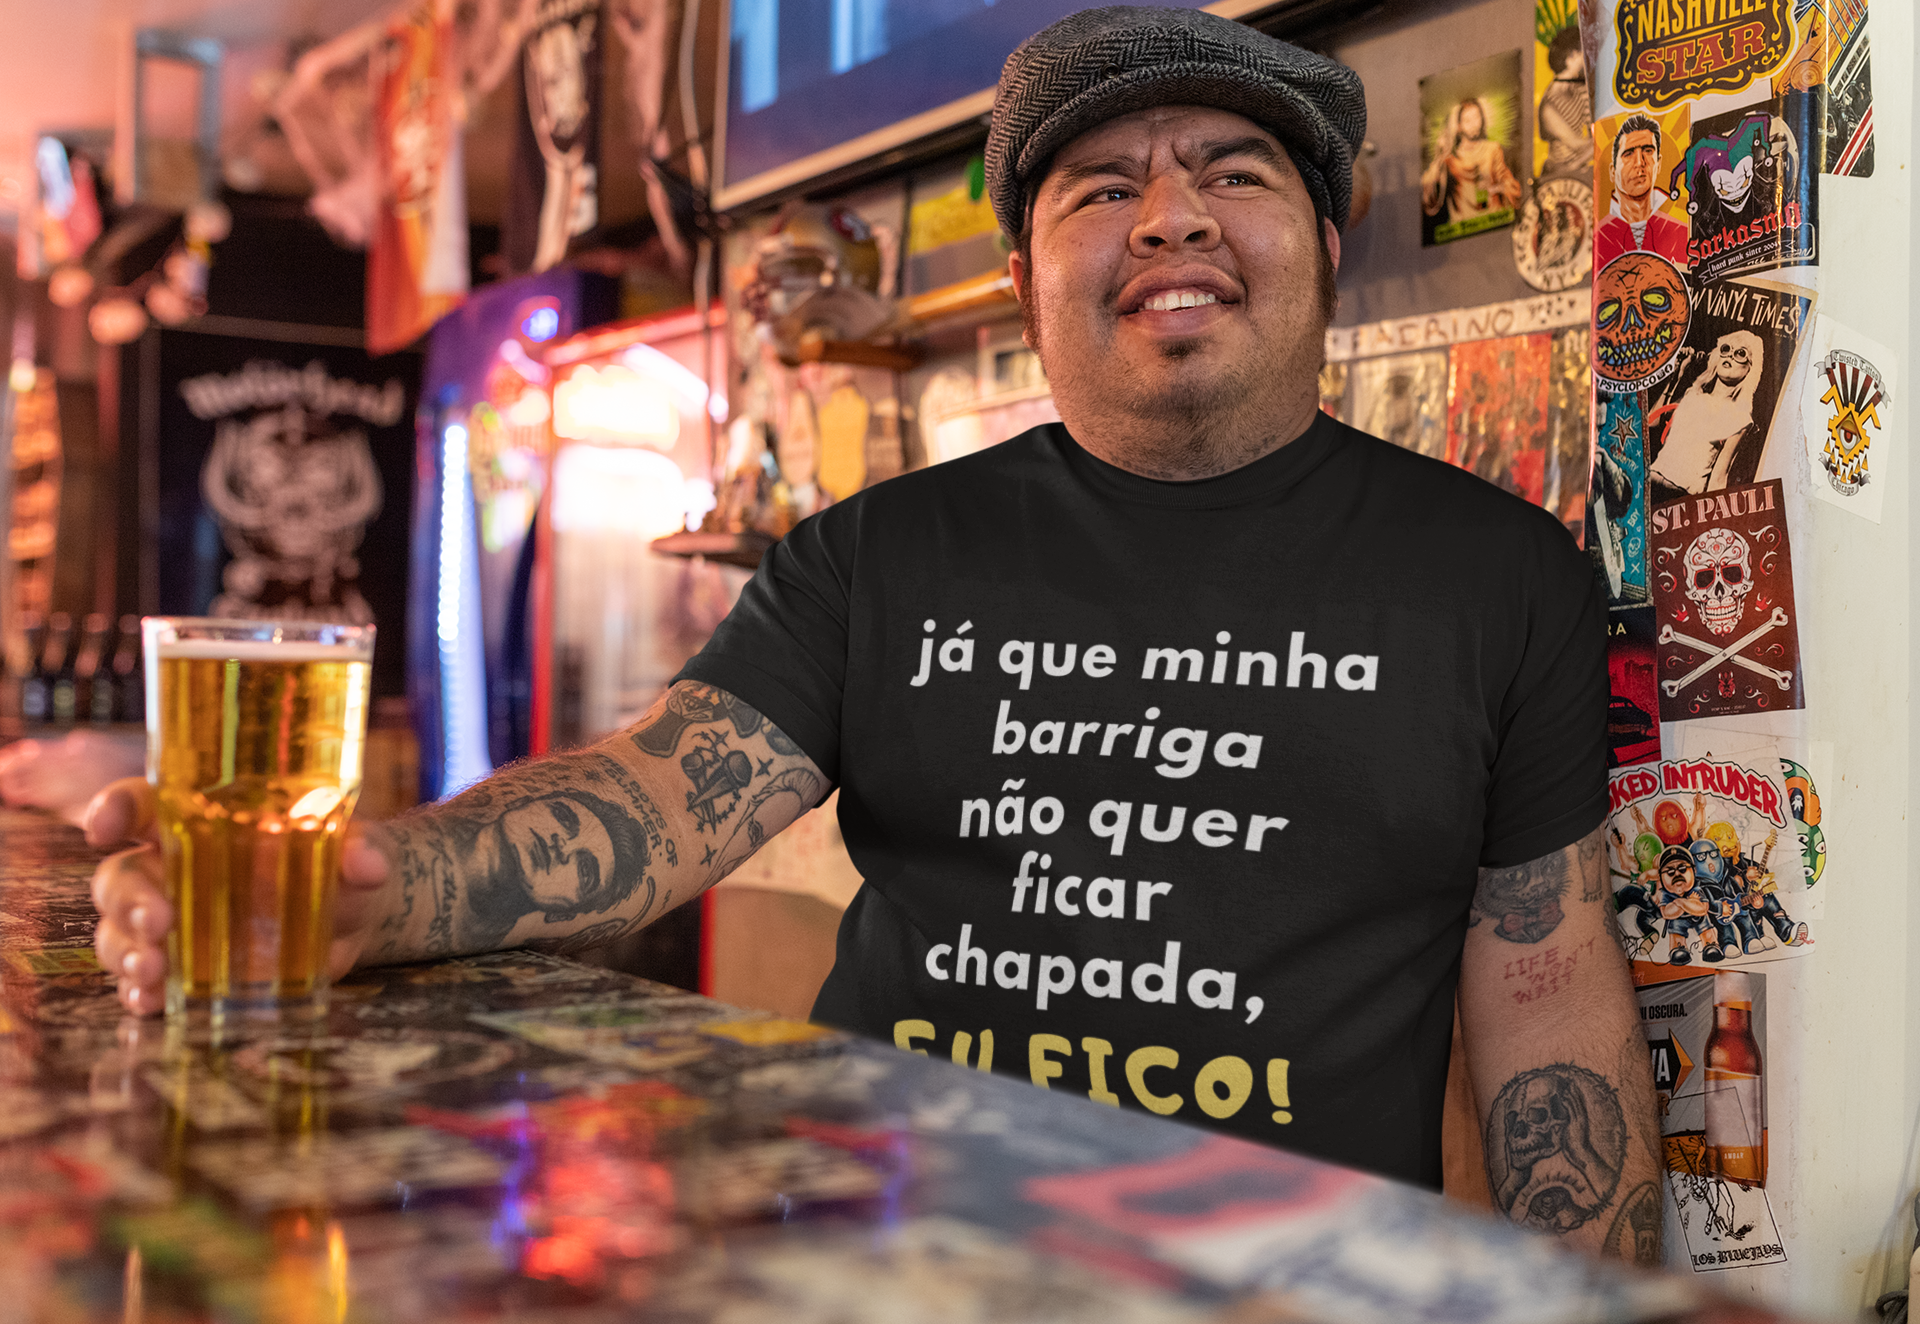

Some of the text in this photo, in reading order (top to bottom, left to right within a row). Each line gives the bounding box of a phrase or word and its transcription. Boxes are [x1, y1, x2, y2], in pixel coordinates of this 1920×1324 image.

[1637, 21, 1767, 84] STAR
[1687, 201, 1803, 269] Sarkasmo
[1627, 507, 1641, 528] BOY
[1652, 485, 1775, 535] ST. PAULI
[910, 618, 1379, 691] já que minha
[992, 700, 1264, 779] barriga
[629, 780, 668, 830] BOYS
[665, 838, 679, 868] OF
[958, 777, 1290, 856] não quer
[1662, 761, 1782, 824] INTRUDER
[1011, 850, 1173, 921] ficar
[925, 923, 1265, 1025] chapada,
[1503, 945, 1559, 980] LIFE
[1648, 1003, 1688, 1020] OSCURA.
[1028, 1033, 1293, 1125] FICO!
[1692, 1252, 1717, 1266] LOS
